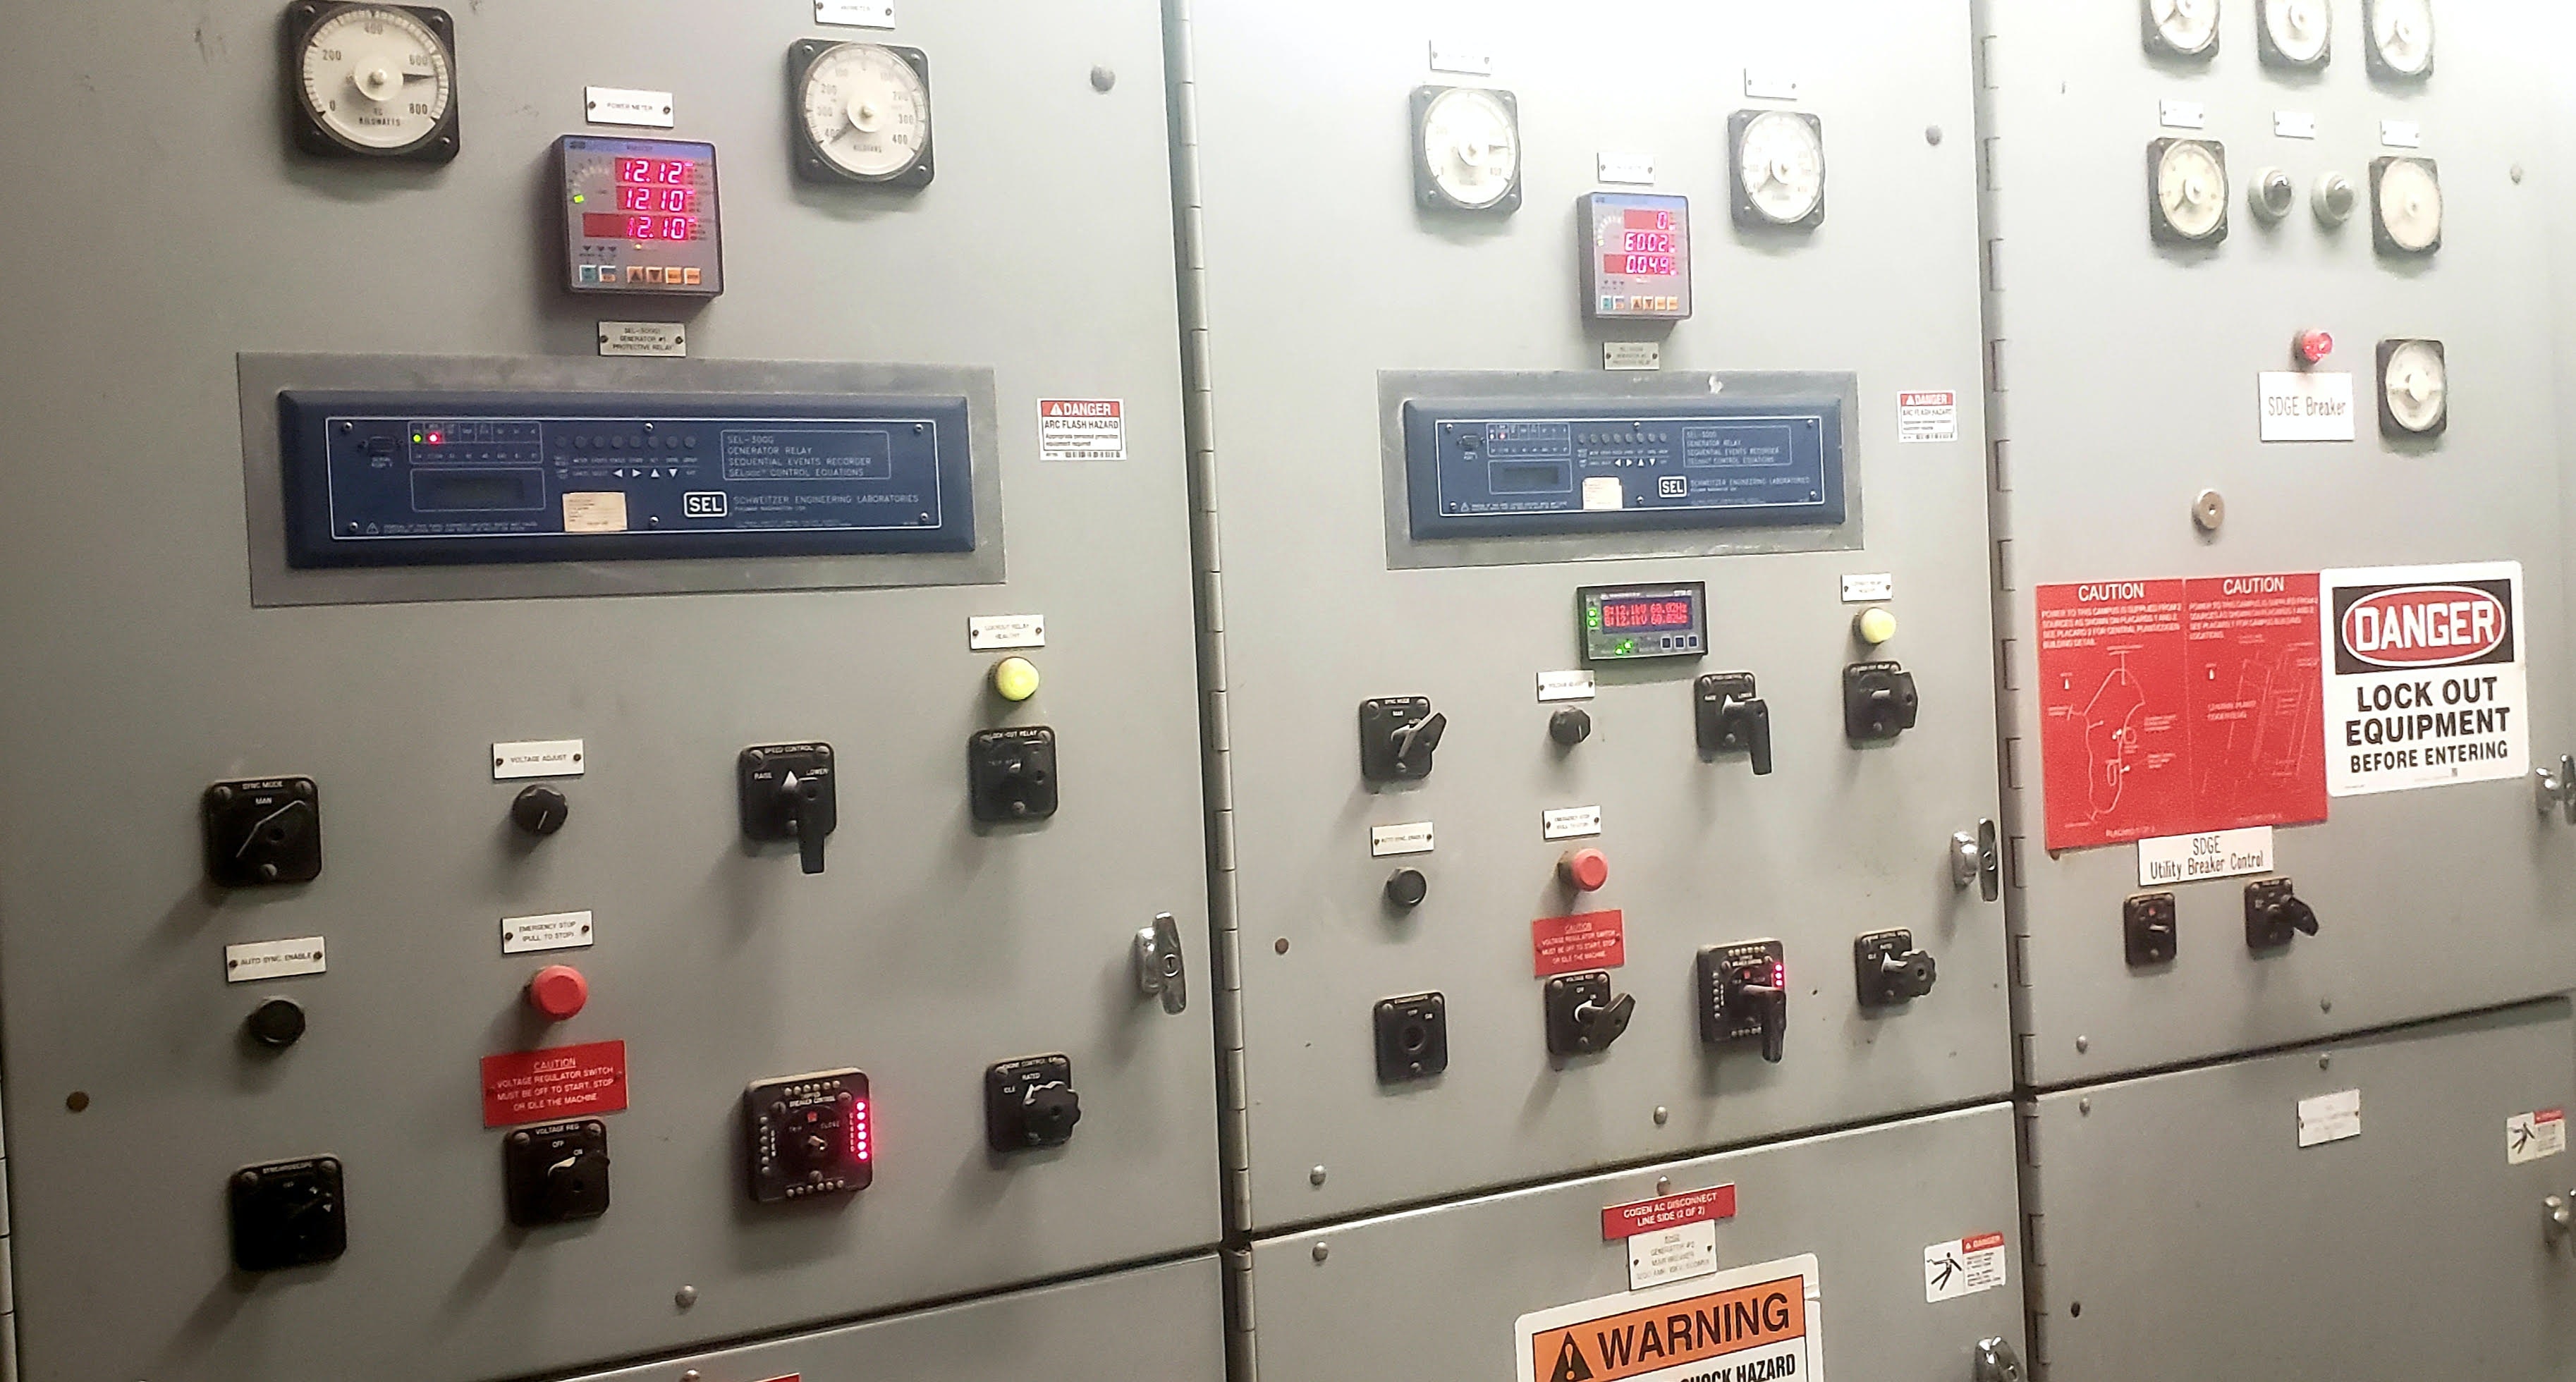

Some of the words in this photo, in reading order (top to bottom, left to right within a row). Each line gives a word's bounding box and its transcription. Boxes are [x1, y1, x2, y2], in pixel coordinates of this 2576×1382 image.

[322, 49, 341, 61] 200
[329, 99, 336, 111] 0
[409, 103, 427, 115] 800
[898, 114, 914, 125] 300
[892, 134, 908, 145] 400
[623, 159, 683, 184] 12.12
[628, 216, 686, 239] 12.10
[1063, 402, 1112, 416] DANGER
[2268, 396, 2300, 417] SDGE
[2305, 396, 2347, 418] Breaker
[1044, 420, 1061, 429] ARC
[1062, 420, 1087, 429] FLASH
[1088, 420, 1119, 429] HAZARD
[727, 446, 779, 455] GENERATOR
[728, 457, 783, 466] SEQUENTIAL
[788, 457, 822, 466] EVENTS
[826, 457, 872, 466] RECORDER
[770, 468, 810, 477] CONTROL
[815, 468, 864, 477] EQUATIONS
[1661, 480, 1684, 494] SEL
[688, 496, 723, 513] SEL
[733, 496, 790, 505] SCHWEITZER
[795, 495, 852, 504] ENGINEERING
[857, 495, 919, 503] LABORATORIES
[2078, 582, 2145, 602] CAUTION
[2223, 577, 2285, 596] CAUTION
[2355, 600, 2495, 652] DANGER
[2357, 680, 2434, 712] LOCK
[2442, 676, 2498, 705] OUT
[2345, 707, 2510, 747] EQUIPMENT
[510, 754, 540, 764] VOLTAGE
[542, 754, 567, 762] ADJUST
[2350, 749, 2418, 773] BEFORE
[2424, 740, 2508, 766] ENTERING
[2192, 835, 2221, 856] SDGE
[2150, 860, 2182, 880] Utility
[2187, 855, 2225, 875] Breaker
[2230, 850, 2264, 870] Control
[518, 923, 556, 932] EMERGENCY
[240, 957, 261, 965] AUTO
[284, 952, 312, 961] ENABLE
[532, 1058, 577, 1071] CAUTION
[496, 1076, 532, 1089] VOLTAGE
[534, 1069, 582, 1084] REGULATOR
[583, 1066, 614, 1077] SWITCH
[497, 1090, 520, 1101] MUST
[522, 1089, 533, 1098] BE
[534, 1087, 548, 1096] OFF
[551, 1084, 563, 1094] TO
[593, 1077, 615, 1088] STOP
[513, 1102, 525, 1112] OR
[527, 1099, 545, 1110] IDLE
[547, 1096, 563, 1106] THE
[564, 1092, 598, 1104] MACHINE
[535, 1125, 565, 1135] VOLTAGE
[1623, 1206, 1653, 1218] COGEN
[1654, 1202, 1666, 1212] AC
[1667, 1192, 1718, 1210] DISCONNECT
[1637, 1215, 1656, 1227] LINE
[1657, 1211, 1675, 1223] SIDE
[1685, 1207, 1696, 1217] OF
[1597, 1292, 1790, 1370] WARNING
[1736, 1354, 1795, 1382] HAZARD
